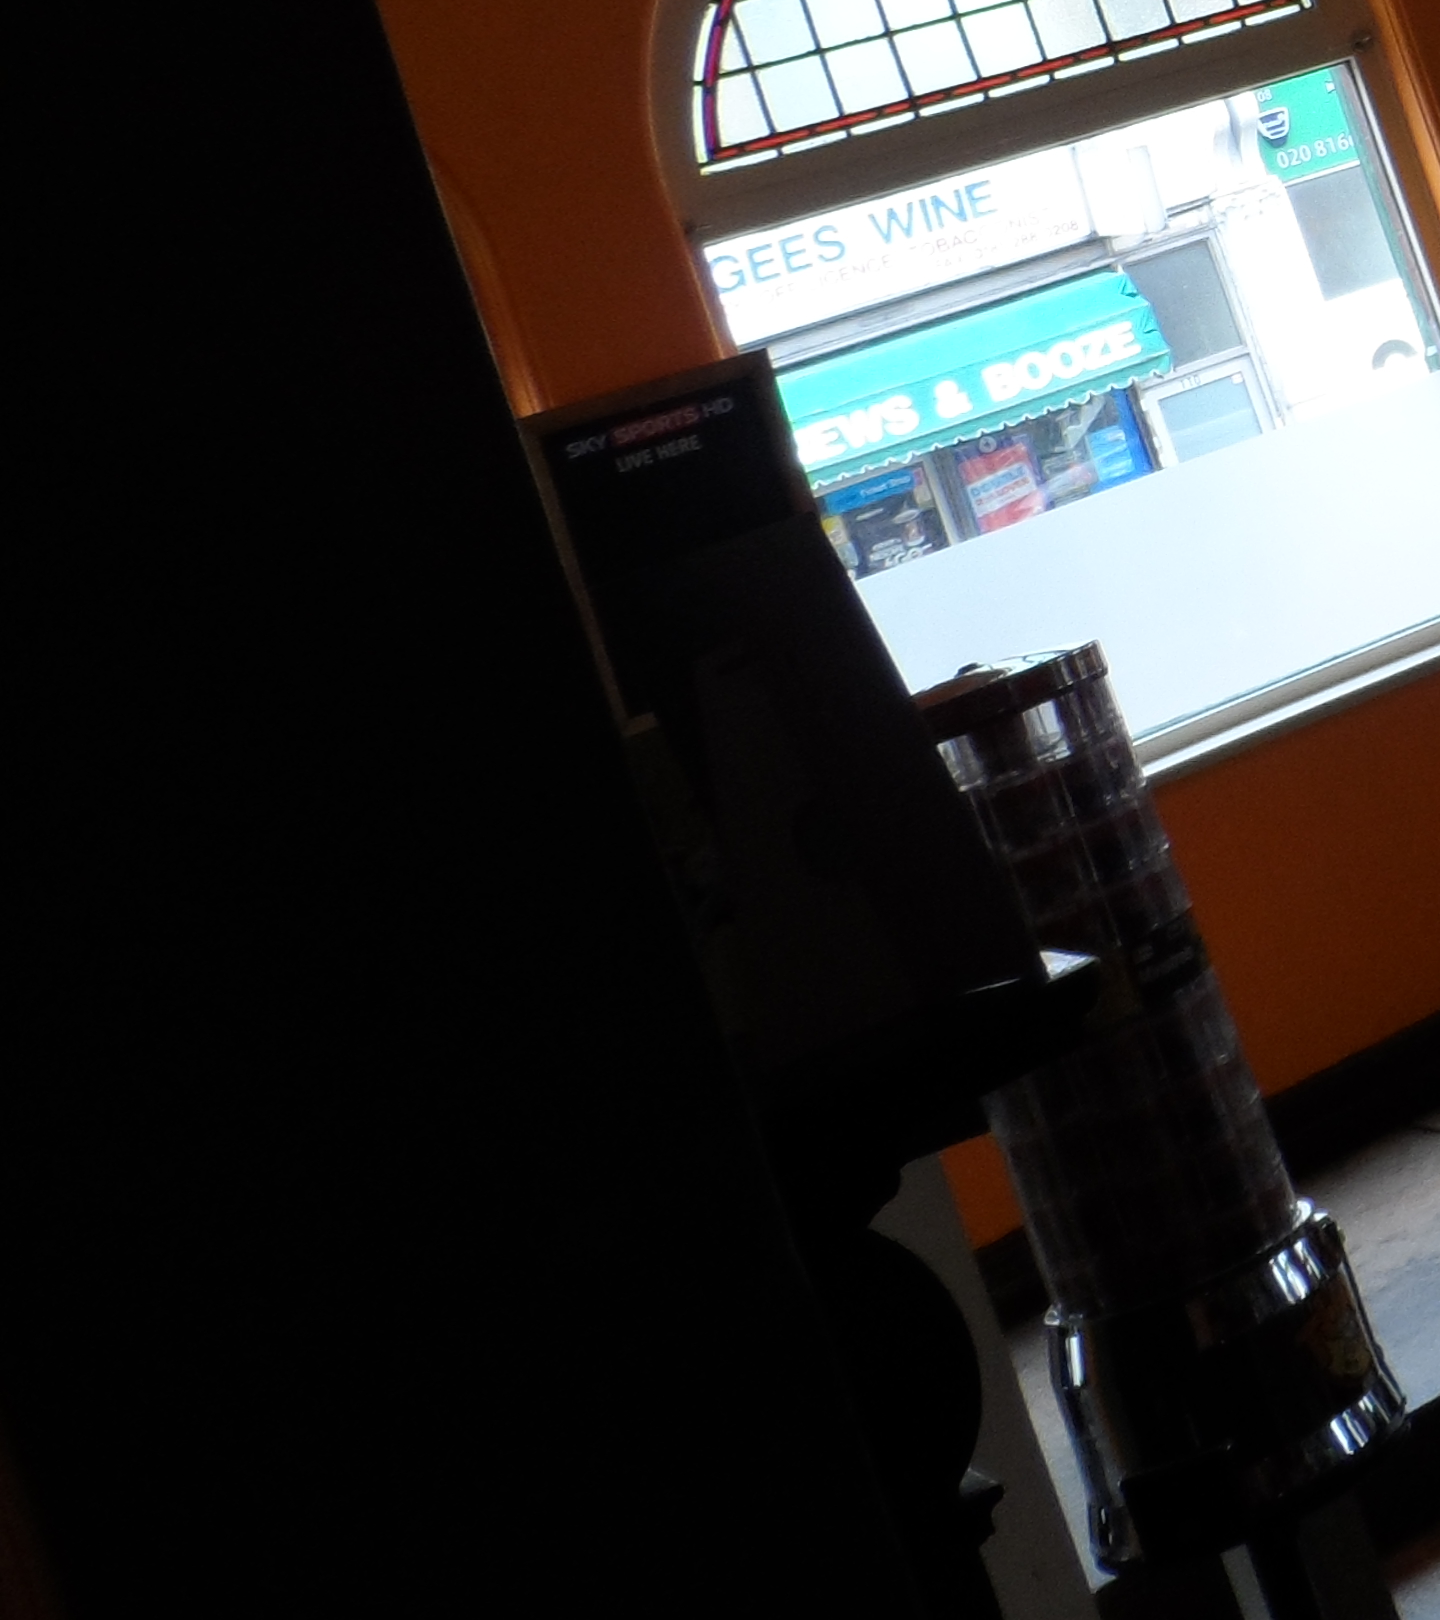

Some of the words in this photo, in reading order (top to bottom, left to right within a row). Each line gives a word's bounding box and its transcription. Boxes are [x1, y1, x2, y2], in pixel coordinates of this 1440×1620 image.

[1276, 144, 1312, 169] 020
[1315, 131, 1355, 159] 816
[709, 225, 847, 294] GEES
[866, 180, 999, 246] WINE
[808, 254, 893, 291] ICENCE
[935, 379, 972, 419] &
[983, 321, 1142, 401] BOOZE
[565, 433, 608, 460] SKY
[611, 405, 701, 446] SPORTS
[701, 396, 734, 418] HD
[615, 448, 655, 473] LIVE
[655, 434, 703, 460] HERE
